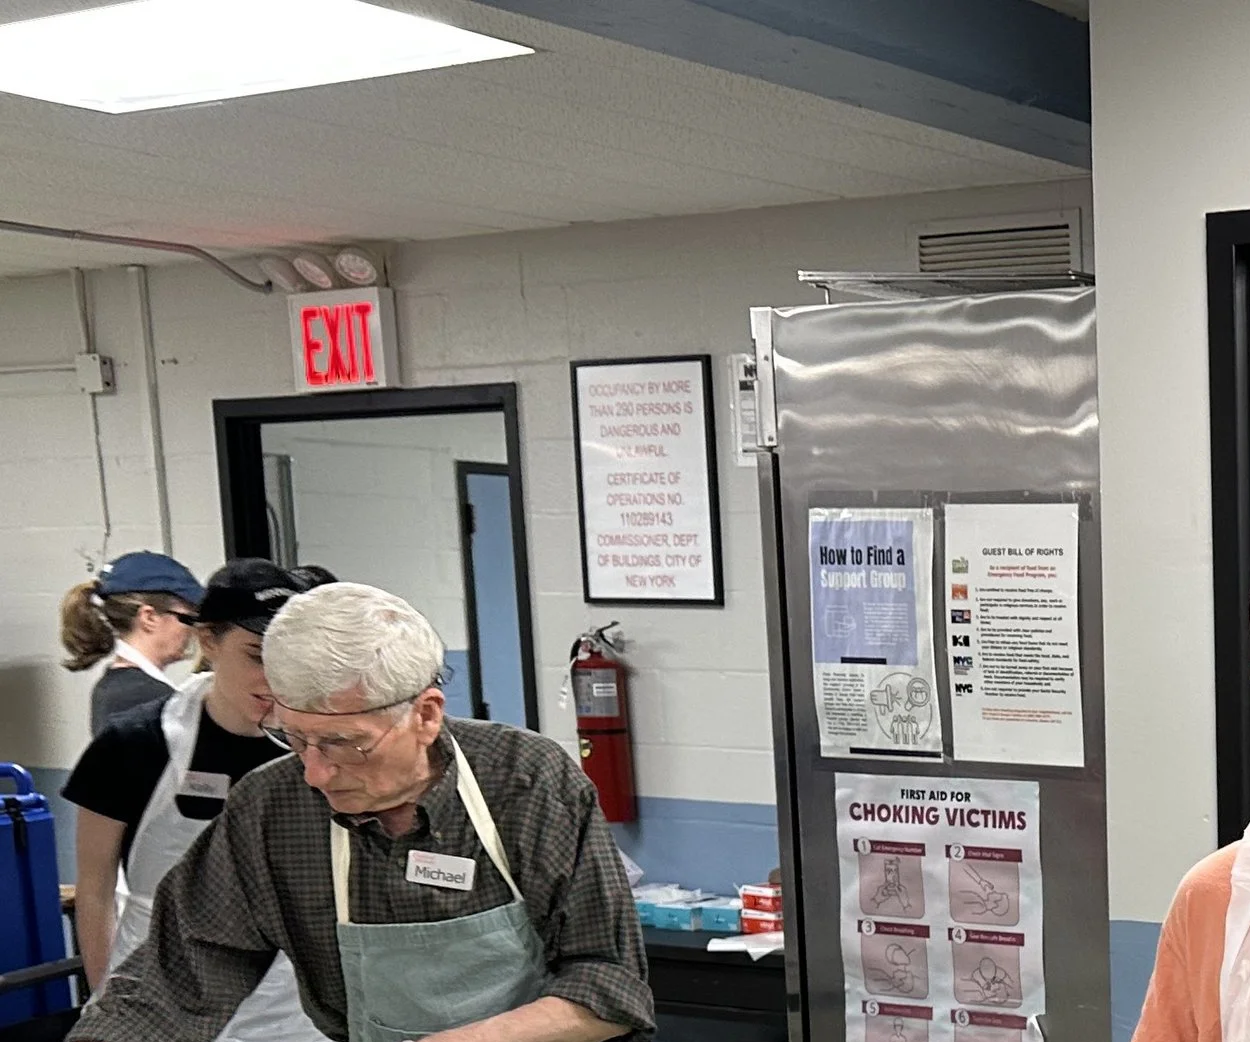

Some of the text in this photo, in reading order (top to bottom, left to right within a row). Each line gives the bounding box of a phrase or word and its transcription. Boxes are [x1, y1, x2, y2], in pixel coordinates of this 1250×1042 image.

[301, 301, 375, 386] EXIT
[589, 380, 692, 397] OCCUPANCY BY MORE
[589, 401, 693, 417] THAN 290 PERSONS IS
[601, 423, 681, 438] DANGEROUS AND
[607, 472, 681, 486] CERTIFICATE OF
[607, 493, 684, 506] OPERATIONS NO.
[820, 545, 906, 566] How to Find a
[982, 547, 1064, 557] GUEST BILL OF RIGHTS
[598, 555, 610, 567] OF
[665, 555, 686, 566] CITY
[688, 555, 702, 566] OF
[626, 575, 676, 587] NEW YORK
[820, 568, 906, 591] Support Group
[953, 655, 973, 666] NYC
[955, 683, 973, 694] NYC
[900, 788, 971, 803] FIRST AID FOR
[849, 802, 1027, 831] CHOKING VICTIMS
[954, 846, 962, 859] 2
[414, 865, 466, 884] Michael
[865, 921, 873, 933] 3
[954, 929, 963, 941] 4
[868, 1003, 877, 1014] 5
[958, 1012, 967, 1023] 6
